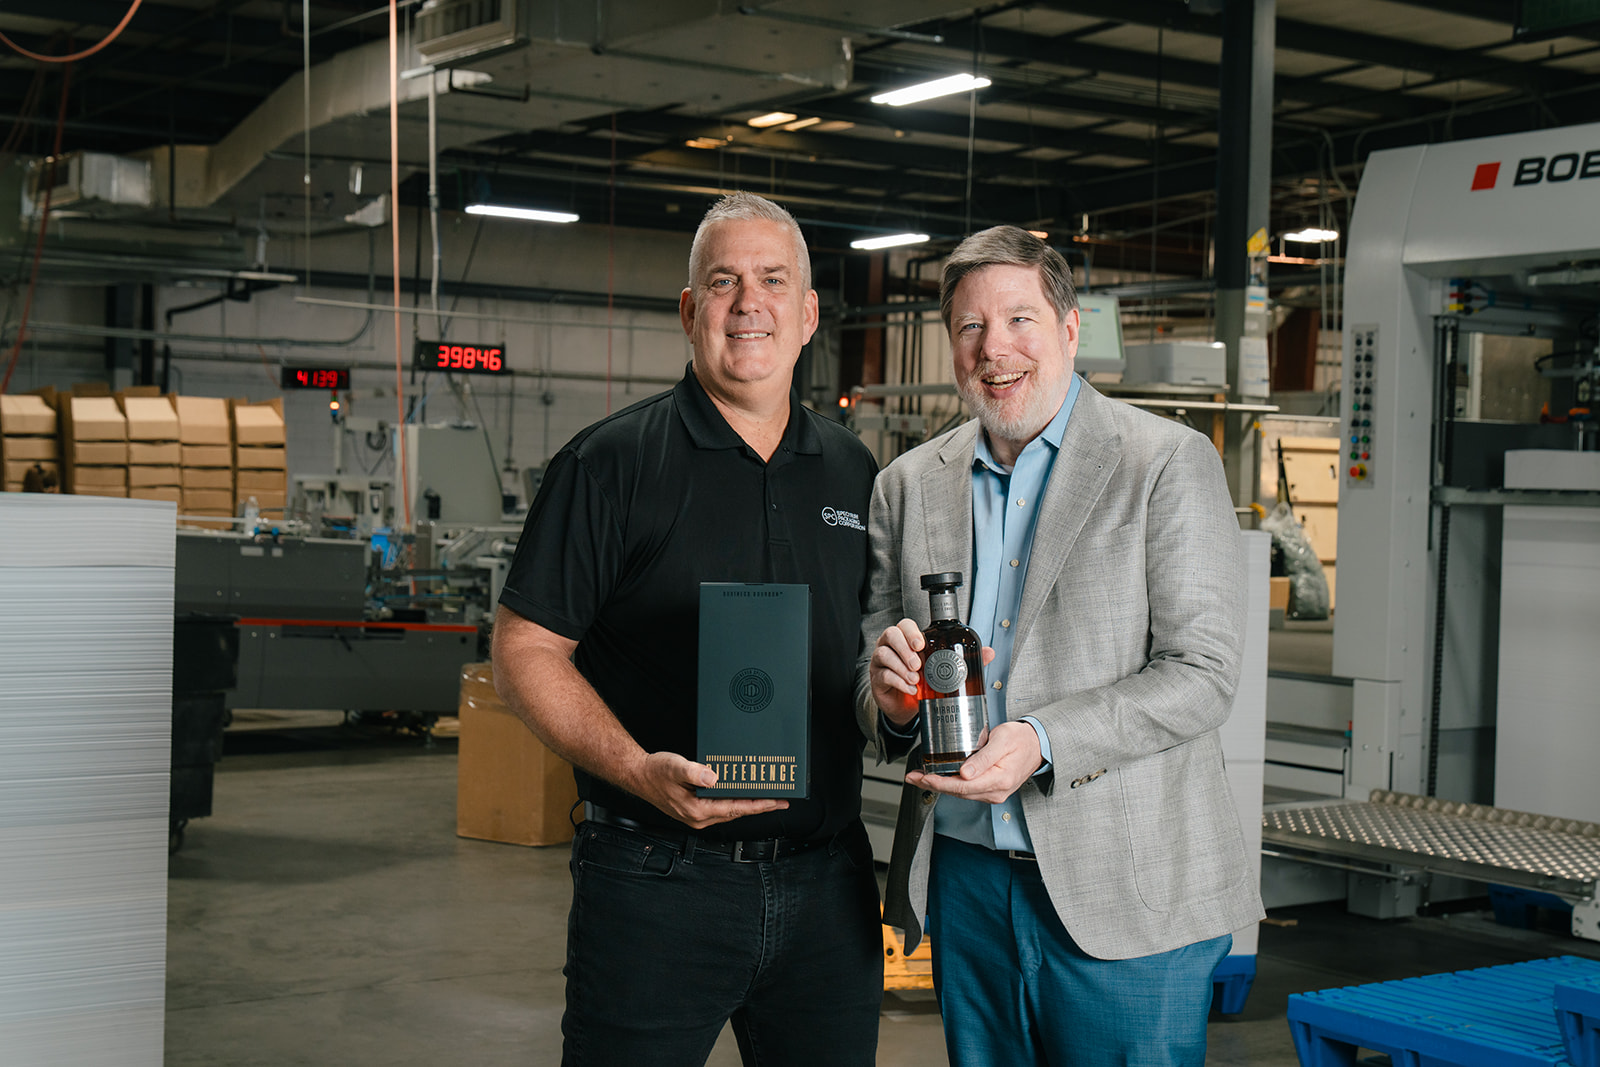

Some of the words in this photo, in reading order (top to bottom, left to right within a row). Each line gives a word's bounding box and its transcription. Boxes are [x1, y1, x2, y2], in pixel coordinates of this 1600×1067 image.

[437, 345, 502, 371] 39846
[934, 704, 960, 714] MIRROR
[936, 714, 958, 724] PROOF
